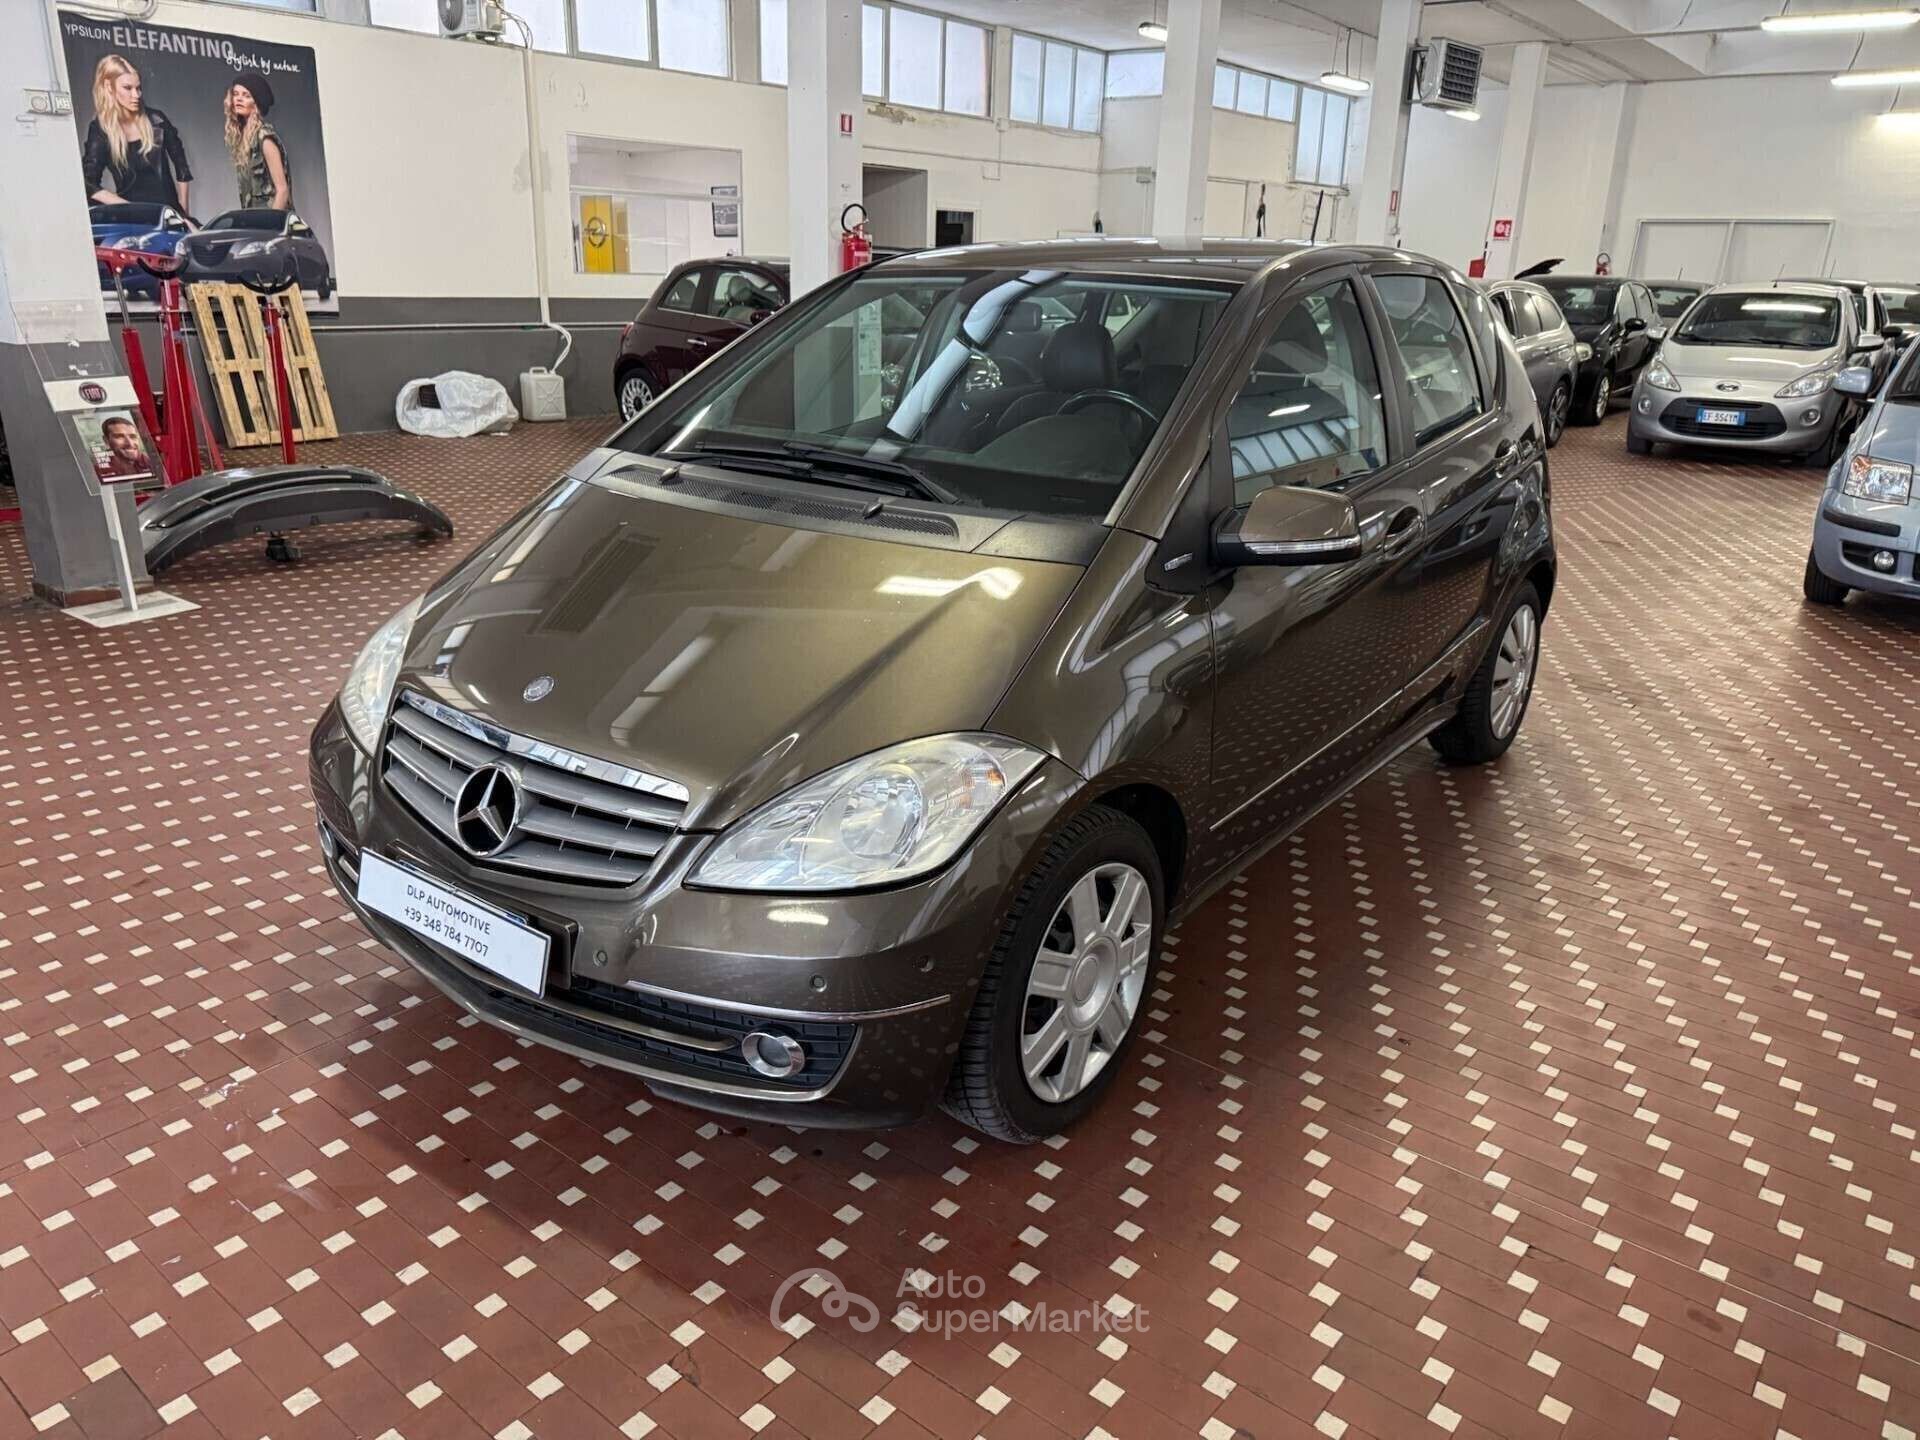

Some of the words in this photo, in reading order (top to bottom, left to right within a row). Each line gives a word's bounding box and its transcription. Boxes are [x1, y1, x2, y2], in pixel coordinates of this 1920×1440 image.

[64, 23, 111, 41] YPSILON
[113, 26, 234, 59] ELEFANTINO
[260, 56, 271, 75] by
[405, 906, 422, 922] +39
[423, 915, 441, 932] 348
[444, 925, 461, 943] 784
[464, 935, 488, 957] 7707
[407, 885, 425, 901] DLP
[427, 896, 491, 935] AUTOMOTIVE
